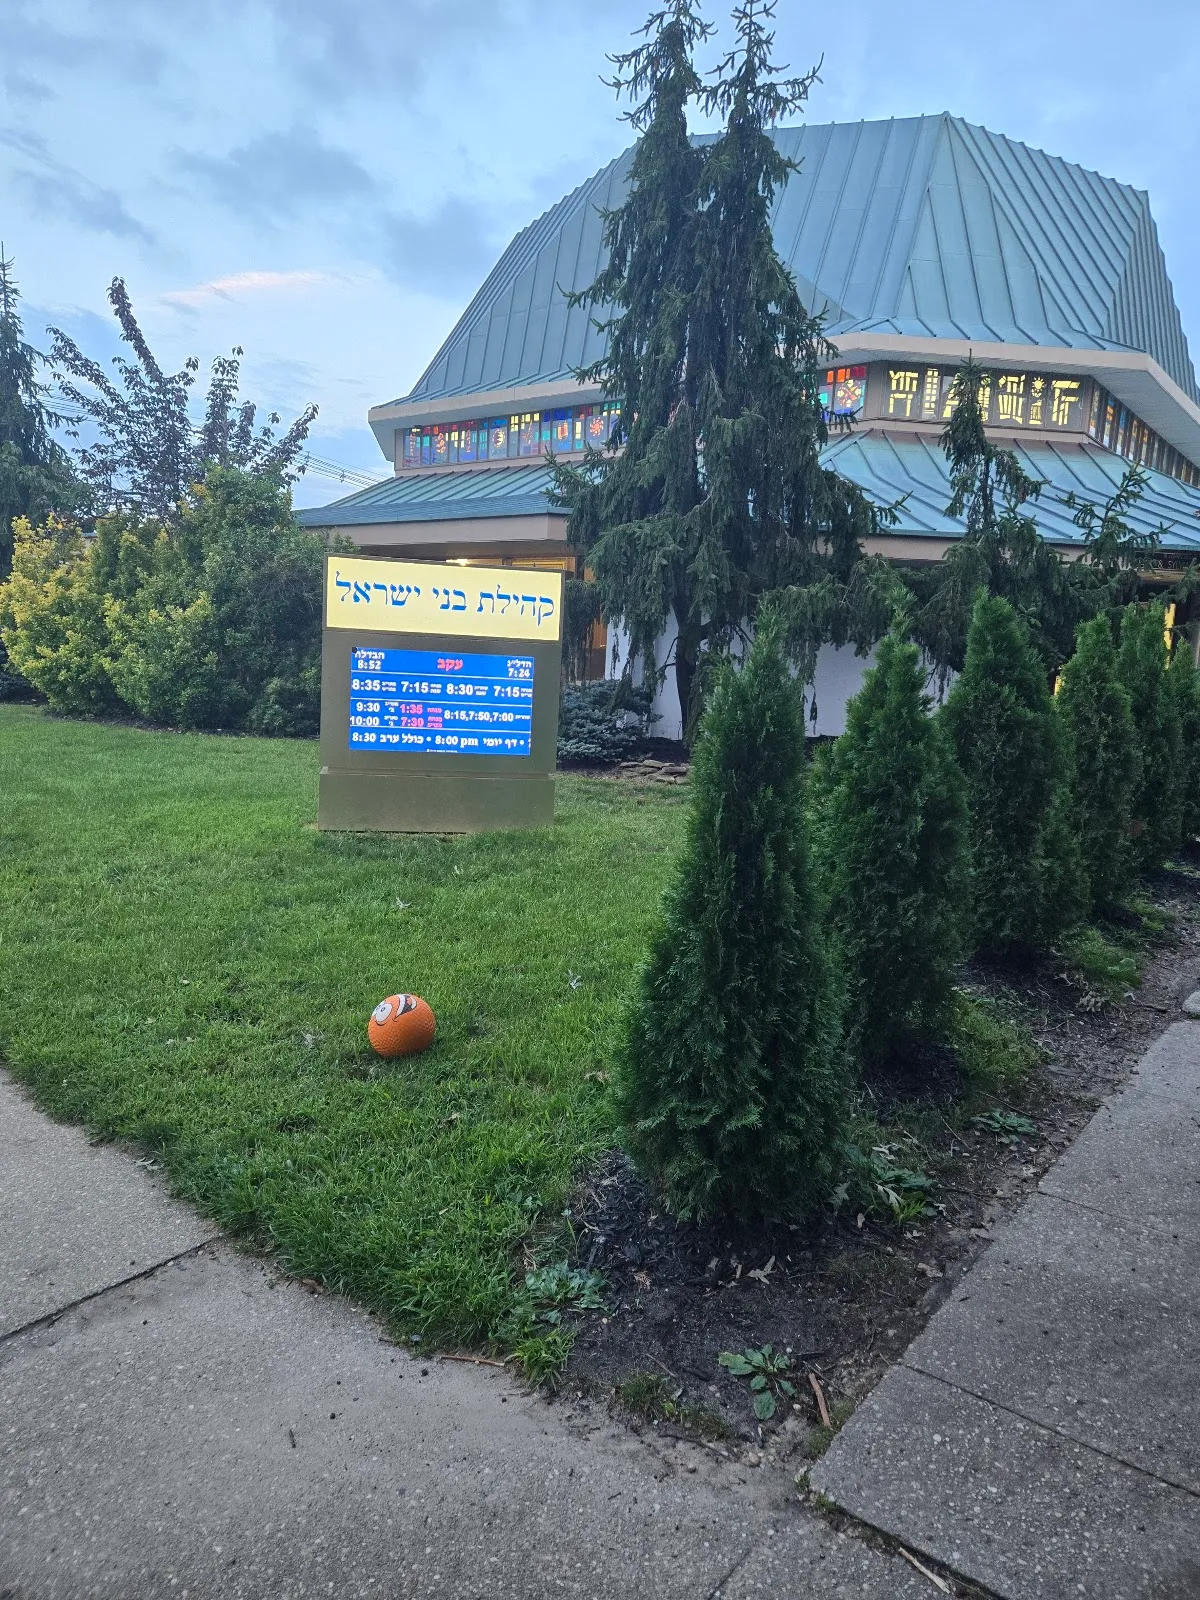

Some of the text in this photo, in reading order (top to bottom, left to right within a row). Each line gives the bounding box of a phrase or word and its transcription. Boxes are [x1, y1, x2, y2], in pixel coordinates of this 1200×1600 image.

[336, 570, 555, 626] קהילת בני ישראל
[354, 650, 385, 660] הבדלה
[358, 660, 382, 670] 8:52
[437, 658, 464, 671] עקב
[508, 668, 530, 678] 7:24
[352, 679, 380, 691] 8:35
[401, 681, 428, 693] 7:15
[446, 683, 473, 695] 8:30
[493, 686, 520, 698] 7:15
[356, 702, 380, 712] 9:30
[400, 704, 423, 714] 1:35
[350, 716, 379, 726] 10:00
[401, 717, 424, 727] 7:30
[352, 732, 376, 742] 8:30
[380, 734, 399, 742] ערב
[402, 733, 424, 744] כולל
[435, 735, 458, 745] 8:00
[482, 738, 502, 746] יומי
[460, 737, 478, 748] pm
[504, 738, 518, 749] דף
